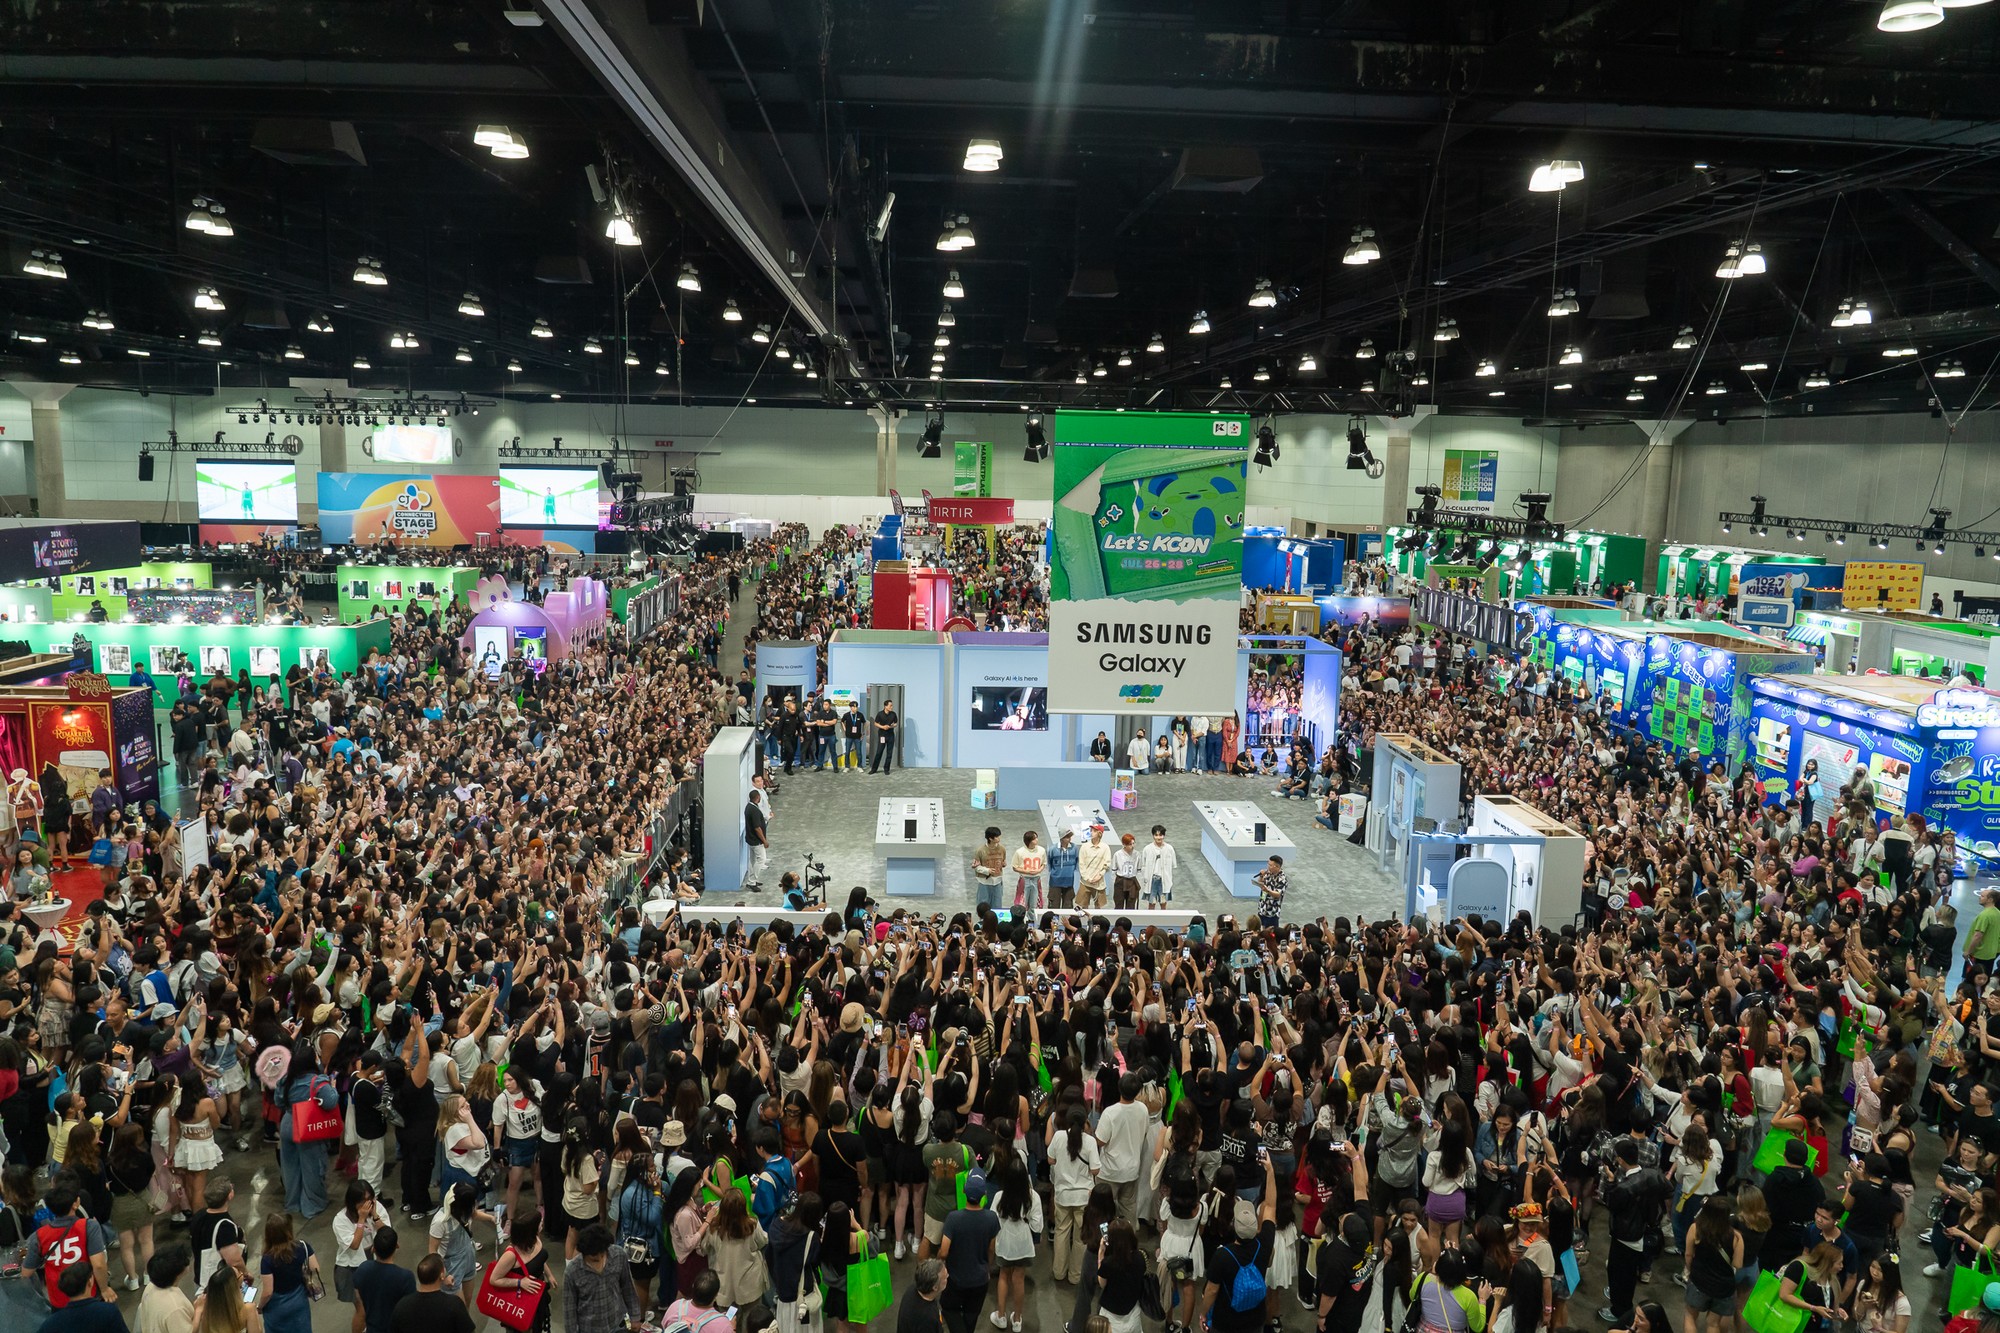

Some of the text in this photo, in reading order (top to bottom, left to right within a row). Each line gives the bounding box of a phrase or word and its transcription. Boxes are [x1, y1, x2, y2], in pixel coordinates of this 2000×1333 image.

[399, 495, 410, 505] CJ
[933, 506, 973, 518] TIRTIR
[395, 519, 434, 528] STAGE
[51, 538, 73, 549] STORY
[1104, 534, 1210, 554] Let's KCON
[52, 548, 79, 559] COMICS
[1122, 559, 1143, 569] JUL
[1755, 577, 1784, 587] 102.7
[1806, 617, 1832, 628] BEAUTY
[1077, 622, 1211, 645] SAMSUNG
[1099, 653, 1186, 678] Galaxy
[984, 675, 1005, 683] Galaxy
[1457, 904, 1481, 912] Galaxy
[518, 1112, 525, 1120] IF
[520, 1115, 537, 1126] YOU
[307, 1119, 337, 1132] TIRTIR
[522, 1122, 538, 1134] SAY
[47, 1236, 82, 1266] 45
[487, 1293, 525, 1319] TIRTIR
